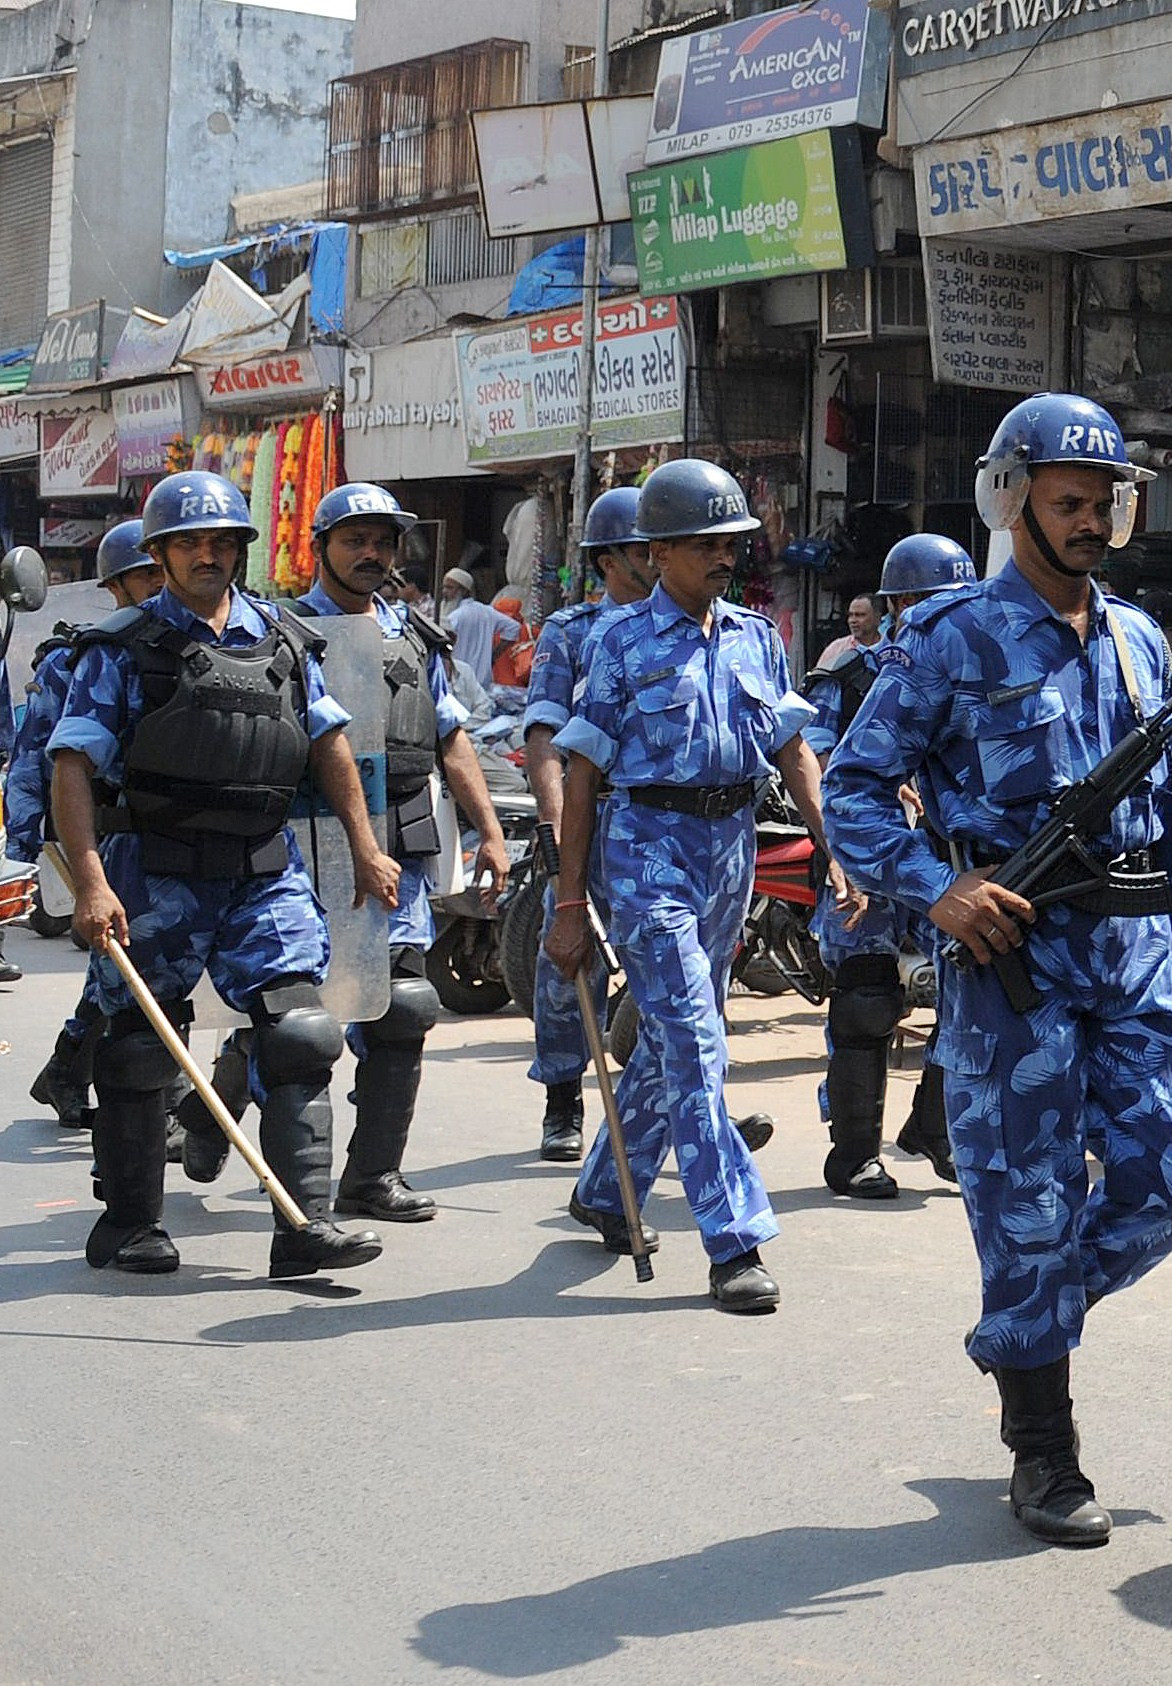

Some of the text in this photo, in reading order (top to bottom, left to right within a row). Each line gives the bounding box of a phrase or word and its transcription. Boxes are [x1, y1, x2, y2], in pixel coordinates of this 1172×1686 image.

[728, 36, 842, 84] AMERICAN
[791, 57, 848, 90] excel
[666, 133, 709, 153] MILAP
[728, 124, 752, 141] 079
[765, 107, 833, 134] 25354376
[671, 212, 719, 244] Milap
[720, 197, 799, 236] Luggage
[537, 404, 583, 427] BHAGVAT
[637, 388, 679, 413] STORES
[1060, 425, 1118, 456] RAF
[180, 494, 232, 519] RAF
[347, 493, 399, 514] RAF
